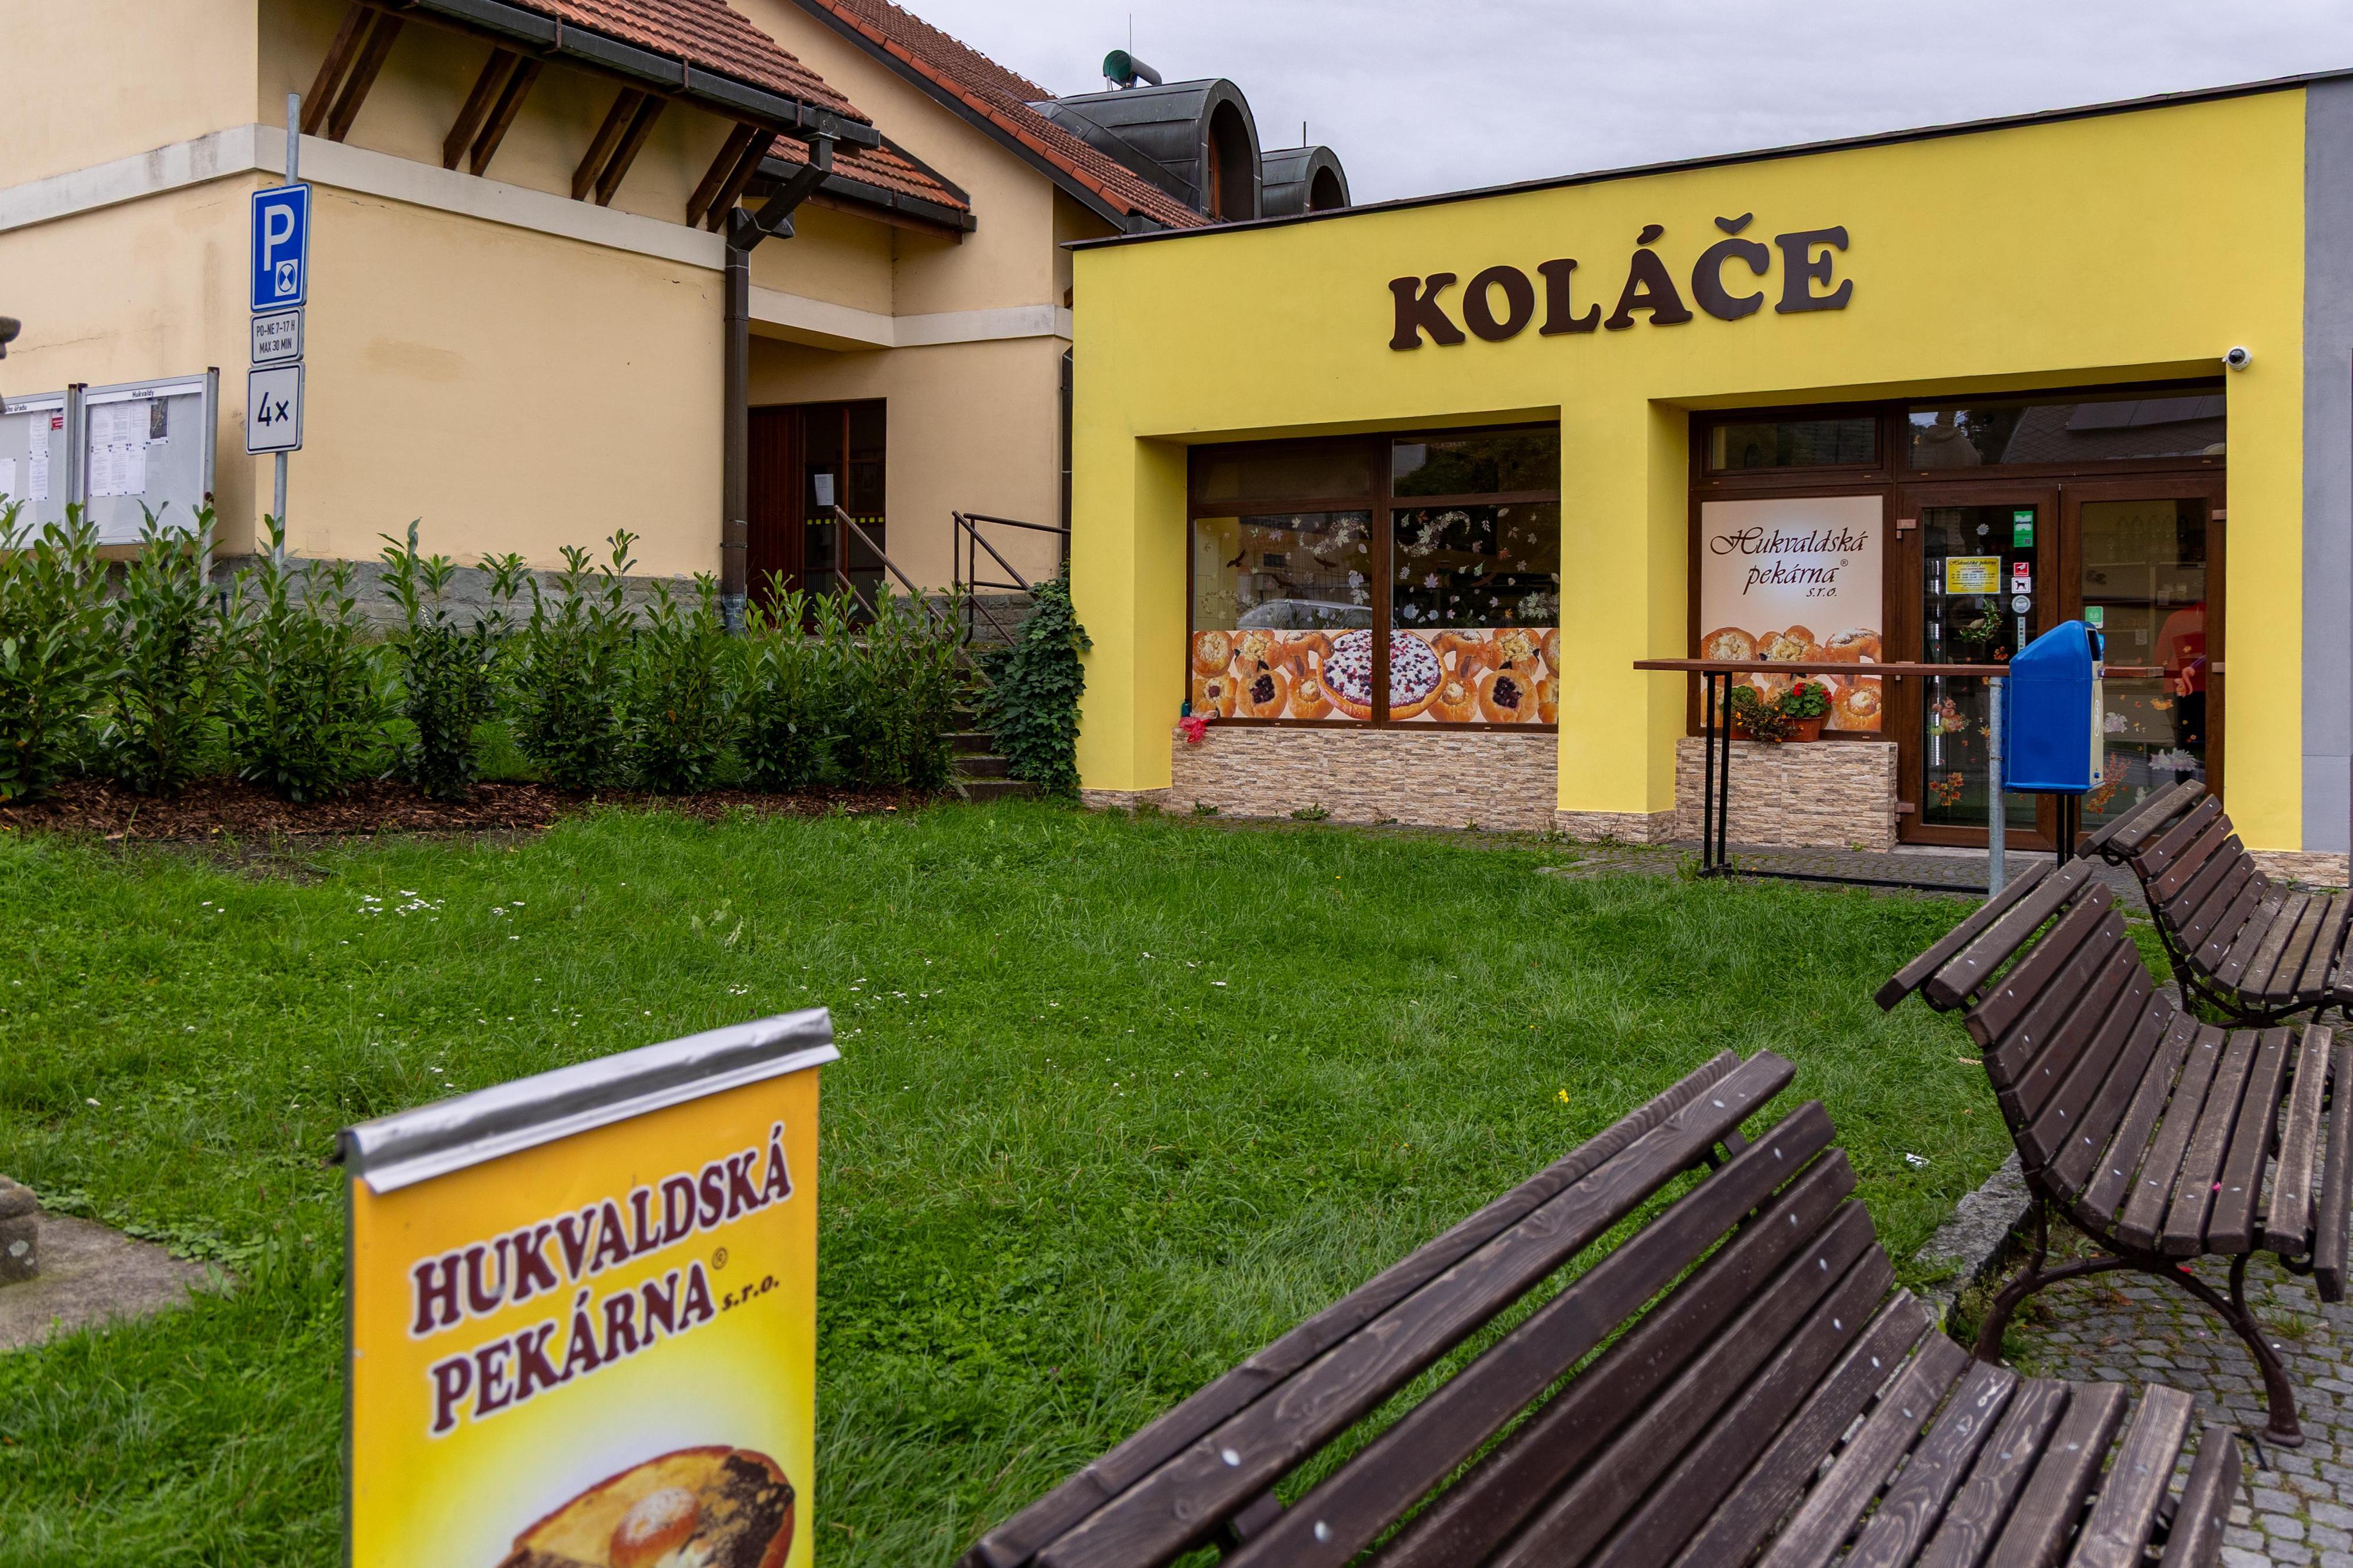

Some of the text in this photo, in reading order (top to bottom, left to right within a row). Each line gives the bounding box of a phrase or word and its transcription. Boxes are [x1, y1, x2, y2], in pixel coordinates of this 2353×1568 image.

[264, 204, 295, 271] P
[1388, 212, 1853, 353] KOLÁČE
[256, 319, 295, 337] PO-NE 7-17 H
[259, 338, 292, 353] MAX 30 MIN
[132, 389, 154, 398] Hukvaldy
[257, 392, 290, 427] 4x
[1710, 526, 1869, 555] Hukvaldská
[1743, 560, 1840, 596] pekárna
[1806, 587, 1837, 598] s.r.o.
[413, 1124, 792, 1335] HUKVALDSKÁ
[432, 1263, 779, 1433] PEKÁRNA s.r.o.
